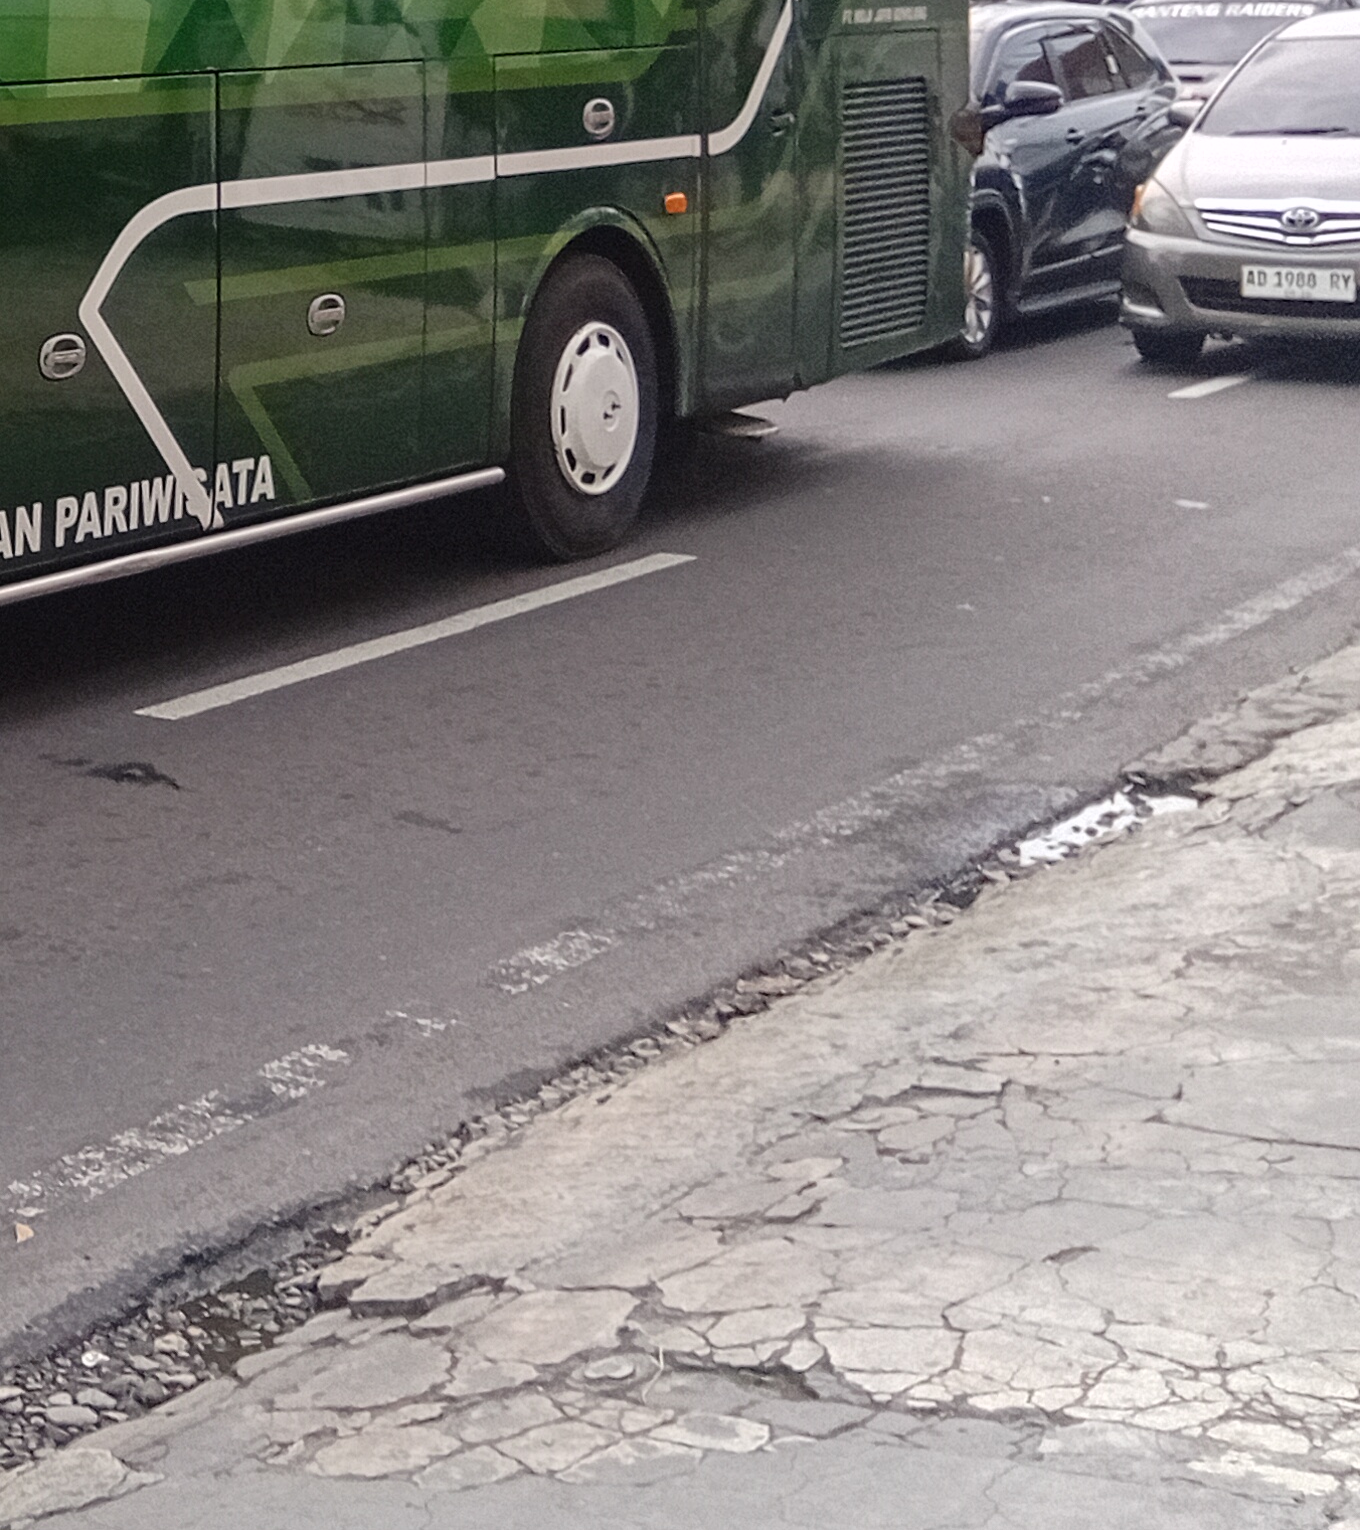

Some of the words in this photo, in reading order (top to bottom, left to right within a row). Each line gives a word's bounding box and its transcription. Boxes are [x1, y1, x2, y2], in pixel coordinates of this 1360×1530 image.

[1224, 2, 1317, 18] RAIDERS
[1246, 270, 1268, 286] AD
[1330, 273, 1352, 290] RY
[55, 455, 276, 548] PARIWISATA
